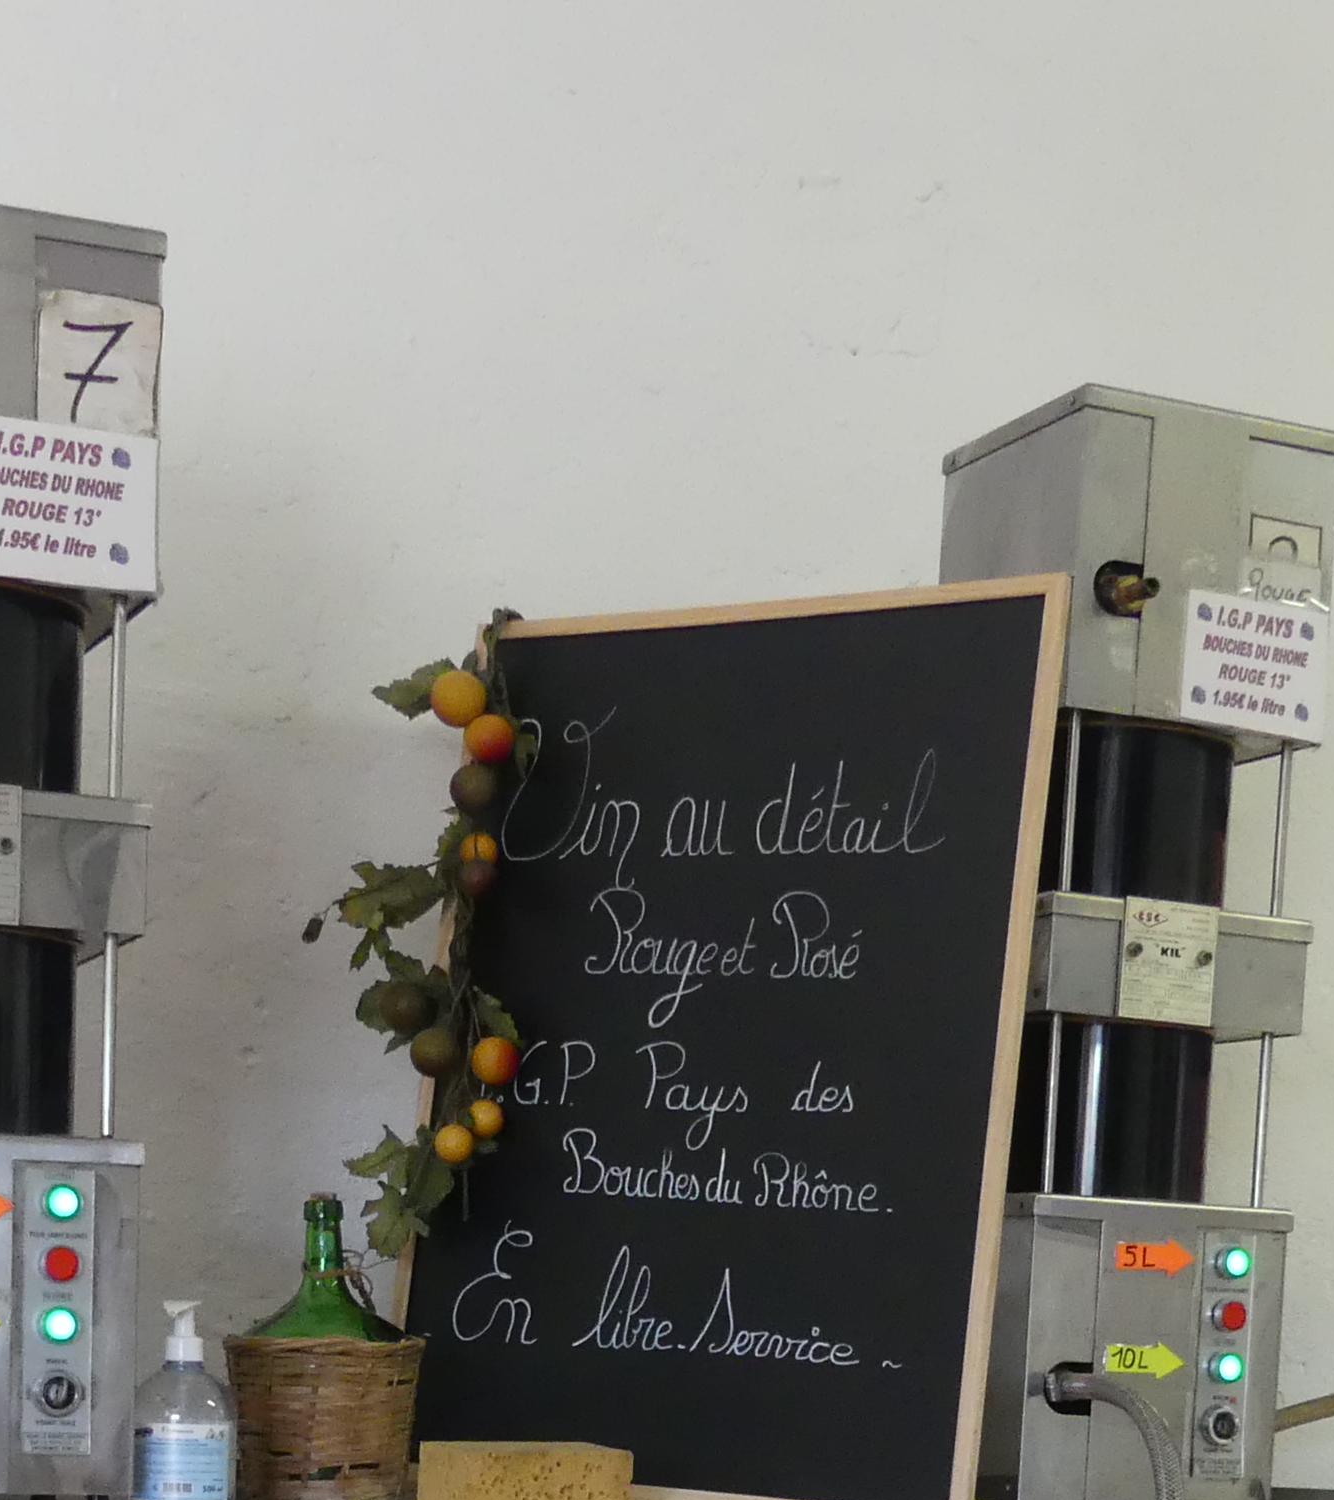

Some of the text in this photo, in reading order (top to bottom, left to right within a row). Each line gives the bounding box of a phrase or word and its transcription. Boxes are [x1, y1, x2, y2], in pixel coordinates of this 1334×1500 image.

[62, 320, 133, 423] 7
[50, 439, 103, 467] PAYS
[51, 473, 72, 494] DU
[74, 476, 125, 501] RHONE
[1, 497, 69, 524] ROUGE
[44, 536, 60, 554] le
[63, 537, 97, 559] litre
[1217, 605, 1294, 639] I.G.P PAYS
[1203, 634, 1309, 668] BOUCHES DU RHONE
[1218, 663, 1267, 687] ROUGE
[1247, 695, 1258, 711] le
[1260, 698, 1286, 717] litre
[502, 706, 946, 890] Vin au détail
[585, 887, 863, 1027] Rouge et Rosé
[635, 1041, 749, 1150] Pays
[792, 1061, 854, 1112] des
[562, 1128, 699, 1202] Bouches
[705, 1148, 742, 1204] du
[452, 1220, 537, 1345] En
